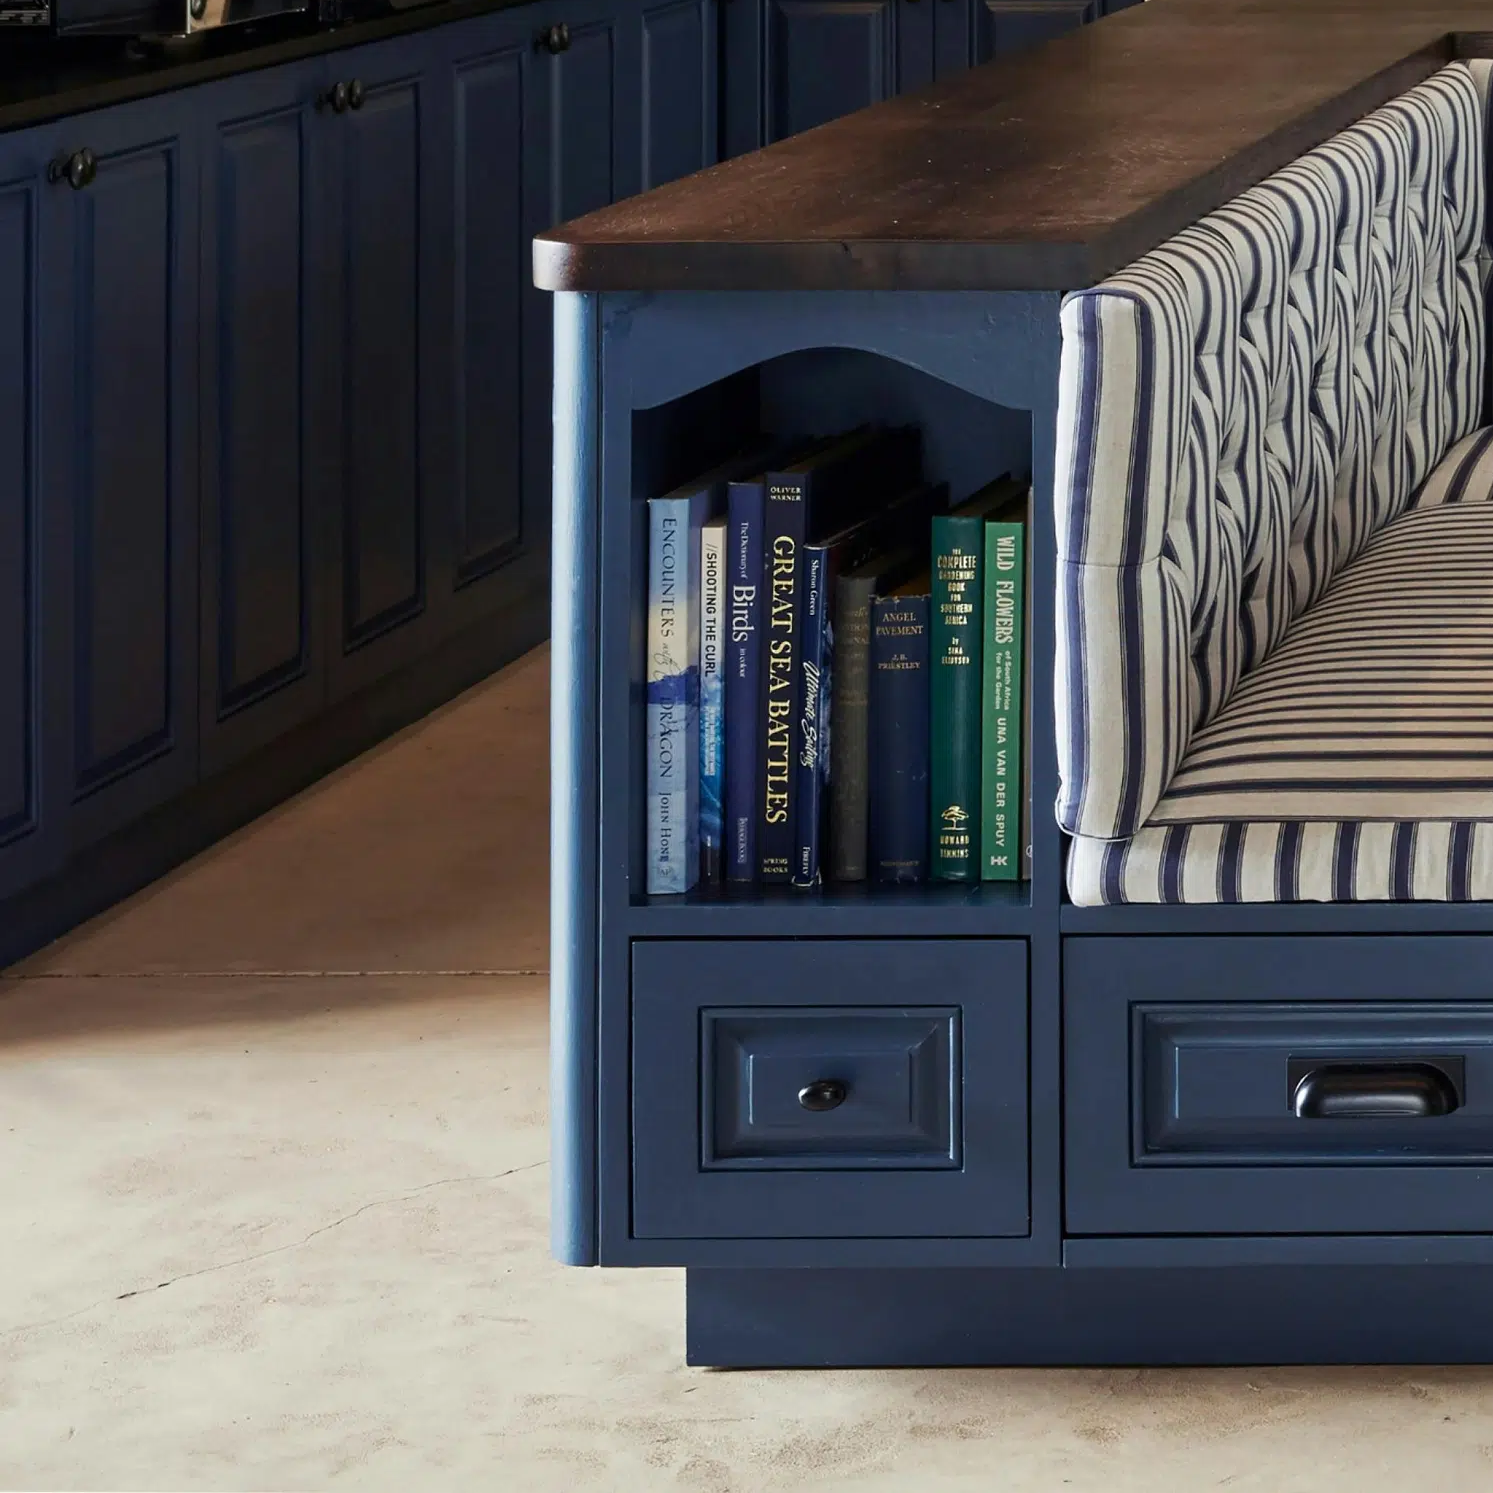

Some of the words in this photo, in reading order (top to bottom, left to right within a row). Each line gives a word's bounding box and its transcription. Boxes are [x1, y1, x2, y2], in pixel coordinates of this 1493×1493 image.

[770, 486, 801, 494] OLIVER
[937, 555, 977, 569] COMPLETE
[996, 536, 1015, 571] WILD
[660, 517, 677, 638] ENCOUNTERS
[772, 535, 796, 634] GREAT
[810, 559, 819, 589] Sharon
[732, 585, 756, 642] Birds
[809, 590, 818, 616] Green
[882, 612, 916, 623] ANGEL
[994, 581, 1014, 644] FLOWERS
[705, 618, 717, 641] THE
[875, 625, 924, 636] PAVEMENT
[704, 647, 717, 678] CURL
[769, 639, 792, 694] SEA
[878, 661, 920, 670] PRIESTLEY
[1004, 661, 1012, 686] South
[803, 660, 820, 720] Ultimate
[659, 696, 674, 778] DRAGON
[801, 719, 817, 769] Sailing
[996, 717, 1006, 744] UNA
[766, 699, 791, 824] BATTLES
[996, 750, 1006, 776] VAN
[658, 792, 672, 824] JOHN
[996, 783, 1006, 808] DER
[658, 827, 672, 863] HONE
[995, 814, 1005, 847] SPUY
